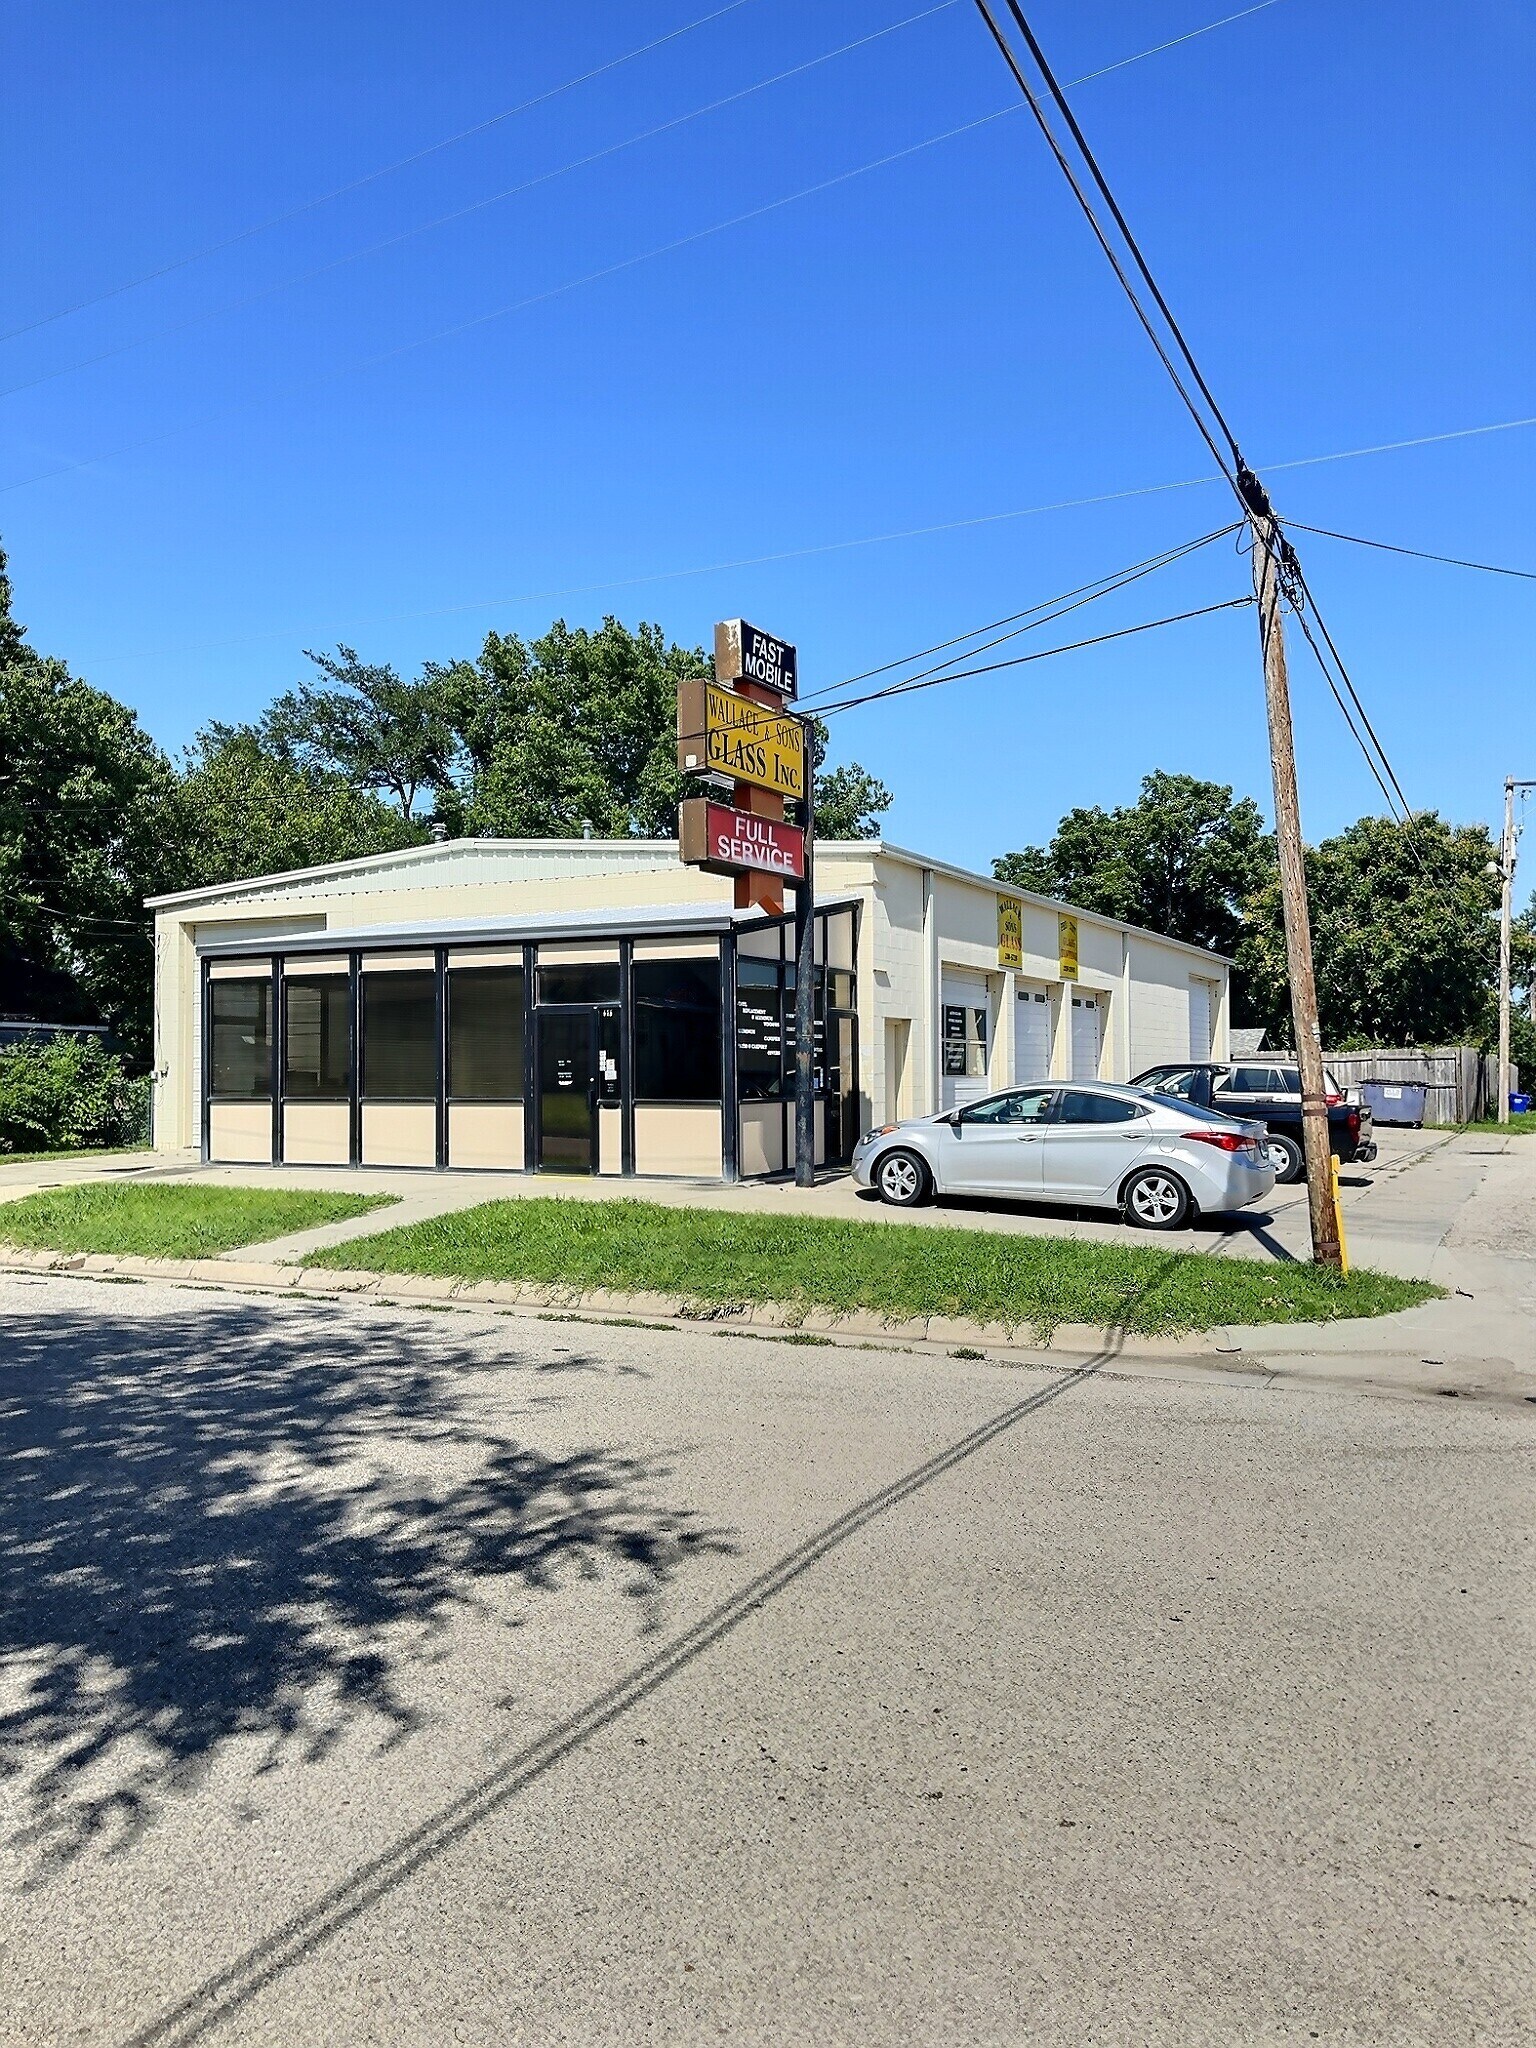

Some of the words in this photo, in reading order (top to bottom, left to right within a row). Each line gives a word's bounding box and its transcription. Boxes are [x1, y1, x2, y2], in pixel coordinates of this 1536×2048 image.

[752, 633, 785, 666] FAST
[745, 652, 793, 693] MOBILE
[709, 693, 759, 736] WALLACE
[764, 725, 771, 742] &
[776, 722, 800, 753] SONS
[708, 727, 767, 778] GLASS
[735, 816, 778, 848] FULL
[717, 834, 794, 868] SERVICE
